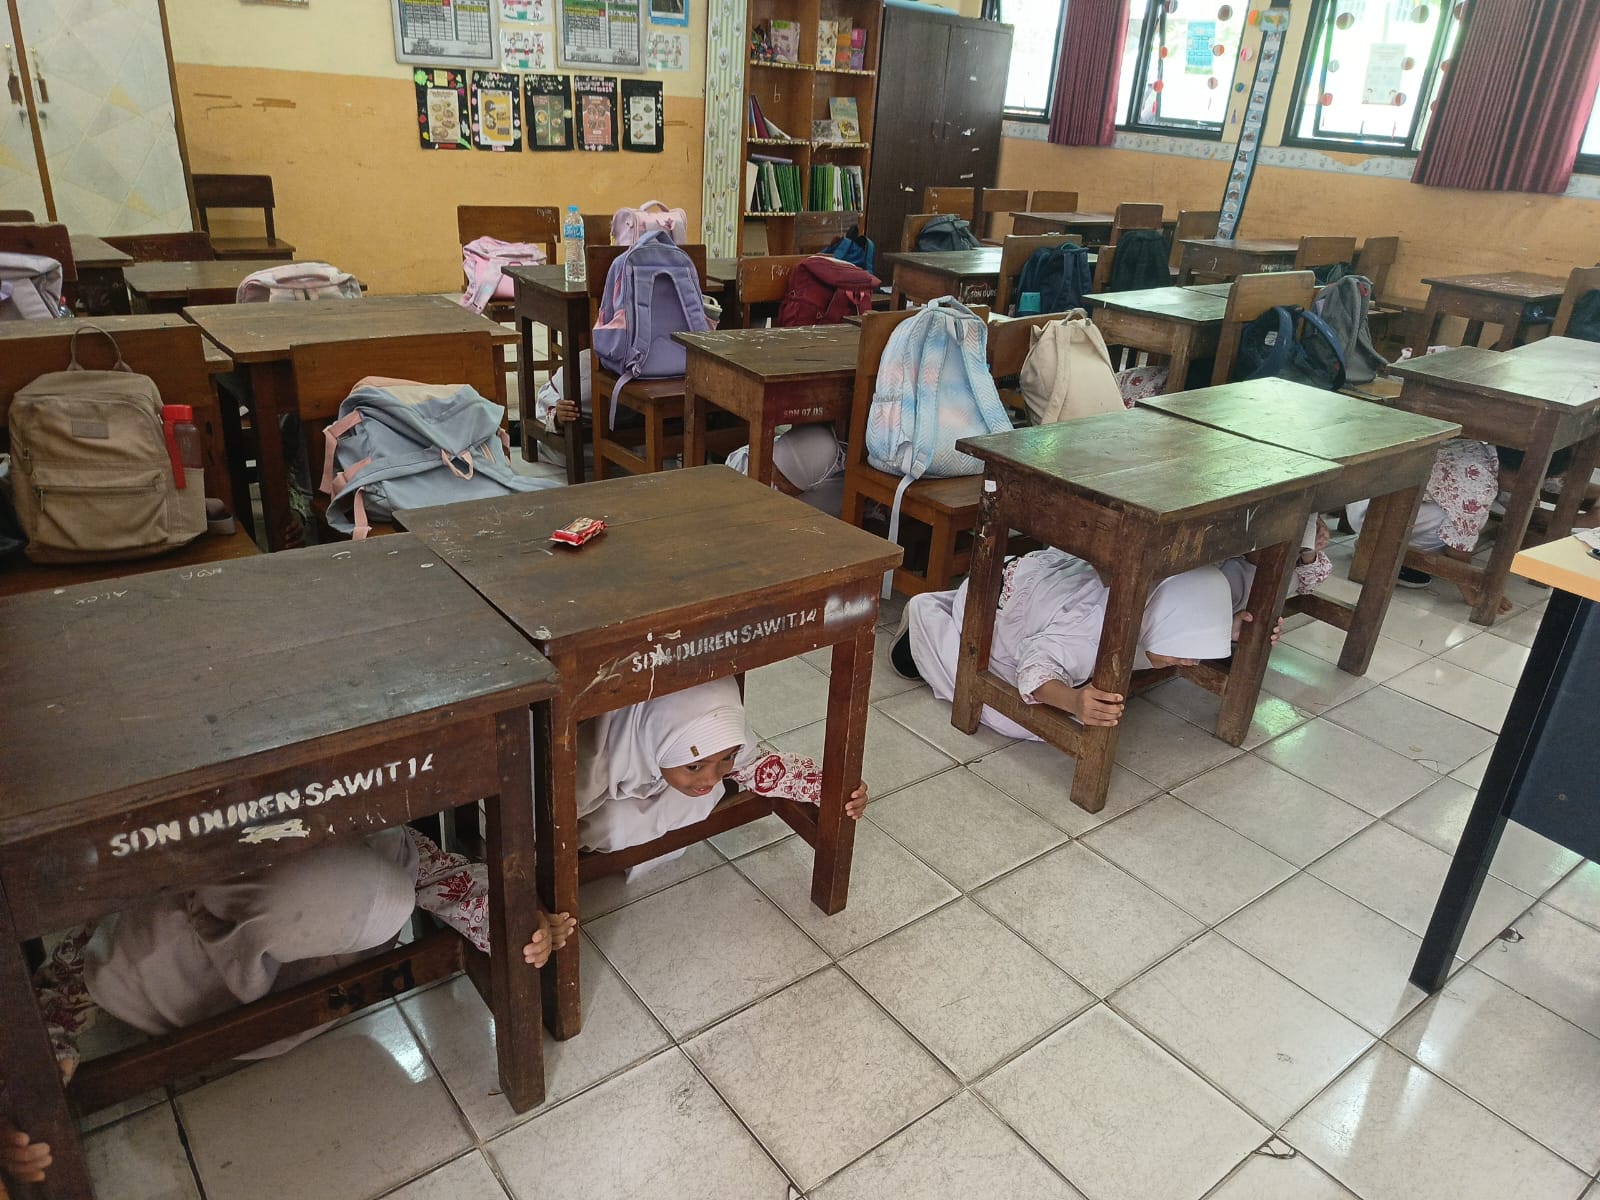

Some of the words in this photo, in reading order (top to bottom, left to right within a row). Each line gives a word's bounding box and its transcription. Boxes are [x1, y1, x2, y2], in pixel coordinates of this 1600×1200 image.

[676, 628, 738, 661] DUREN
[740, 612, 797, 643] SAWIT
[799, 608, 817, 626] 14
[110, 820, 182, 857] SDN
[188, 788, 301, 837] DUREN
[305, 761, 402, 807] SAWIT
